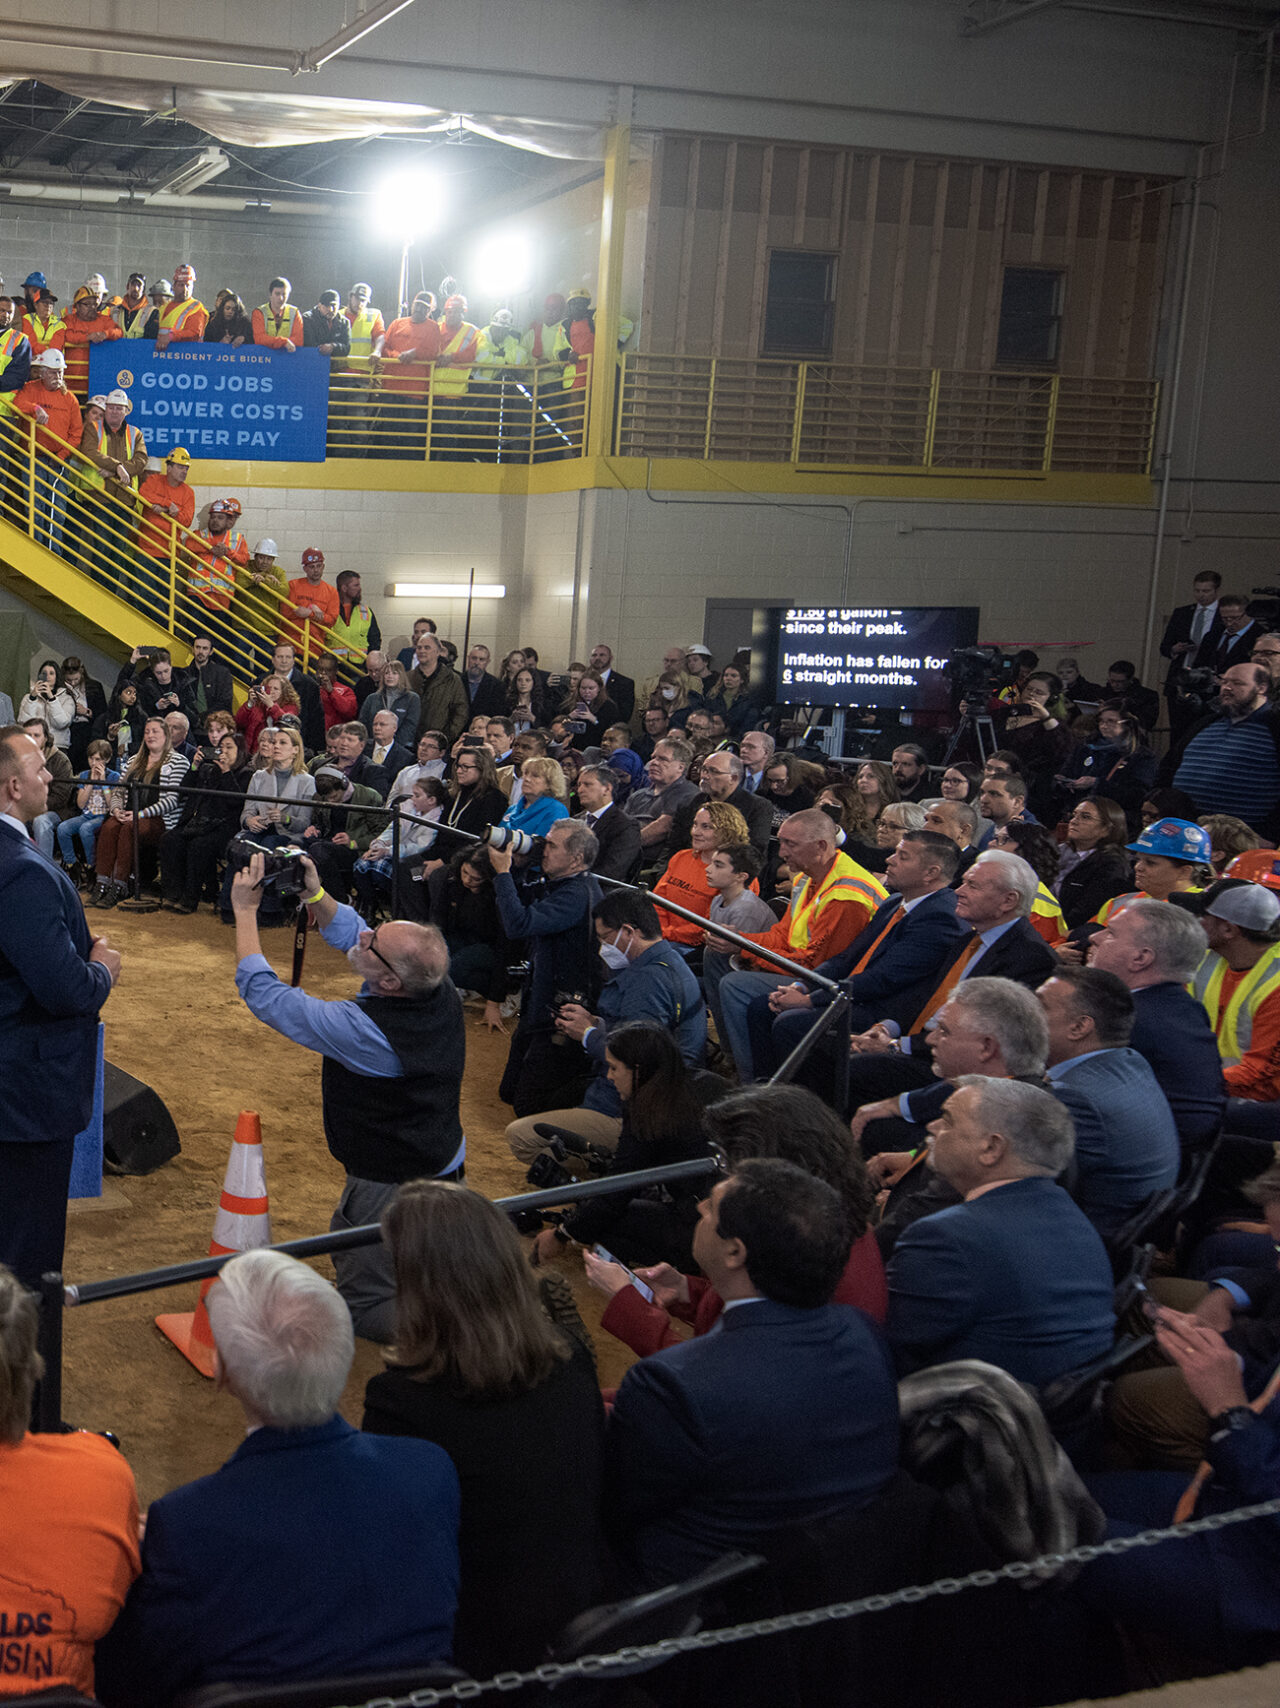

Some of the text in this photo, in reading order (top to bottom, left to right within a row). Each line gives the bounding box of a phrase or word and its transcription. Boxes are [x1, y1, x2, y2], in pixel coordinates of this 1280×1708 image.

[152, 351, 272, 364] PRESIDENT JOE BIDEN
[141, 372, 274, 393] GOOD JOBS
[140, 400, 304, 421] LOWER COSTS
[143, 427, 281, 447] BETTER PAY
[785, 621, 908, 637] since their peak.
[784, 653, 949, 669] Inflation has fallen for
[782, 669, 918, 686] 6 straight months.
